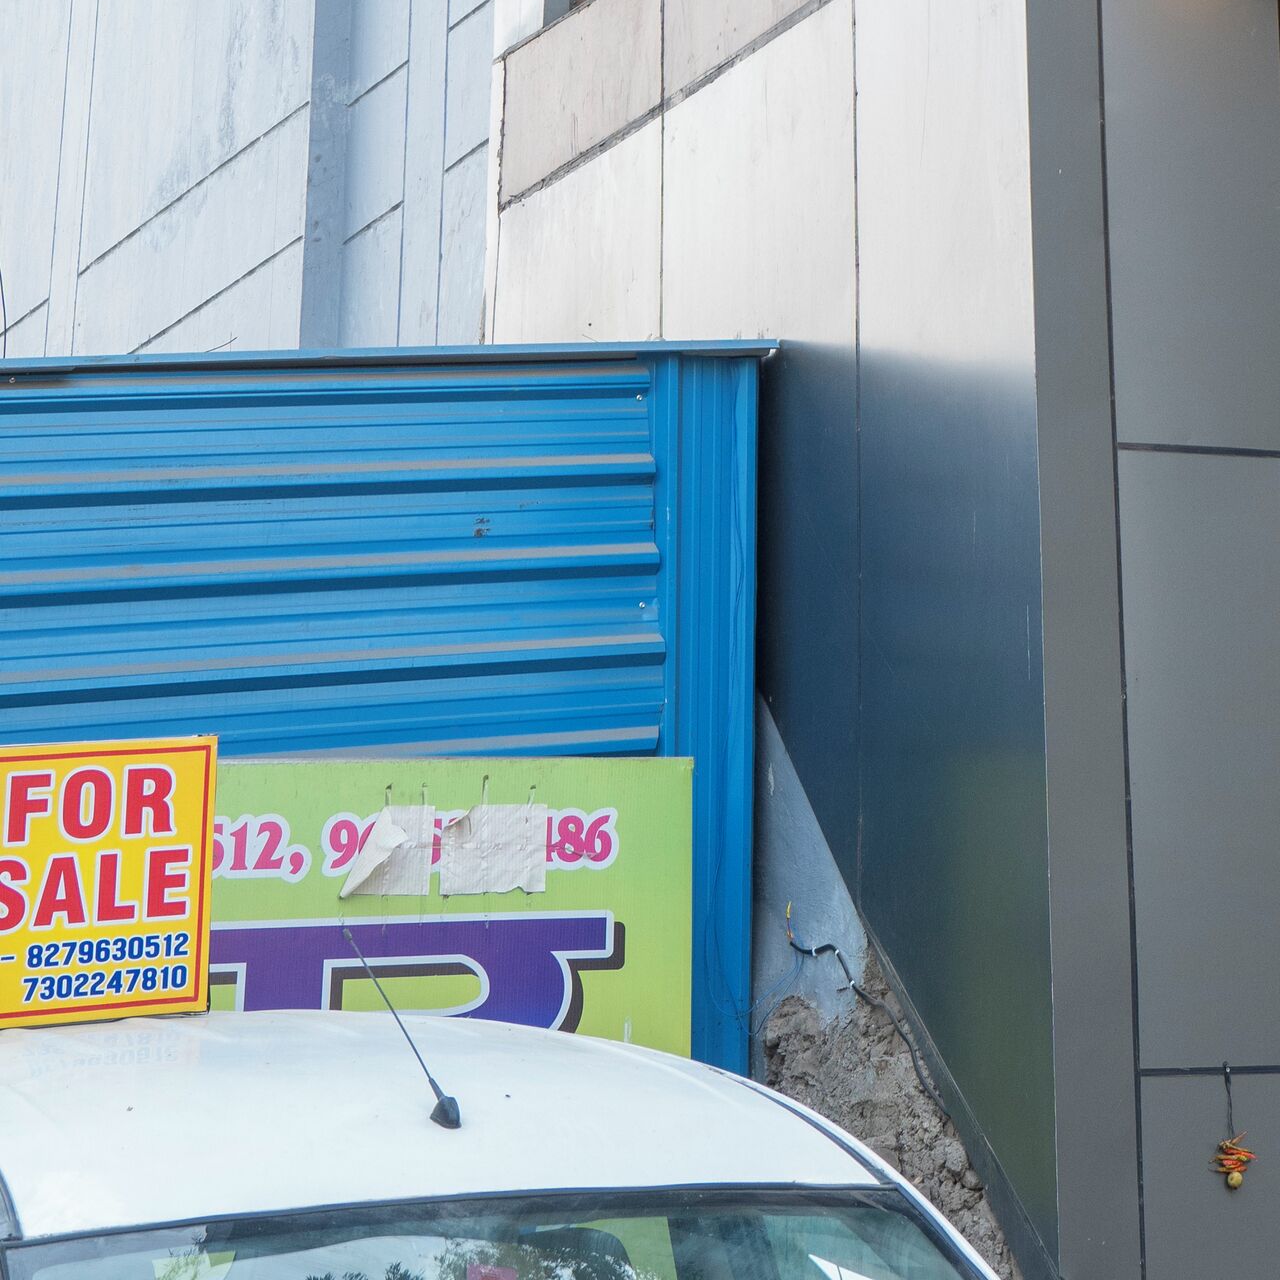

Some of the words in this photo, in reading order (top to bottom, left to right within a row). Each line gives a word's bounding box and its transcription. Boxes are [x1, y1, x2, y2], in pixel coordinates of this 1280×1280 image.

[7, 767, 174, 843] FOR
[0, 848, 190, 931] SALE
[26, 932, 190, 969] 8279630512
[23, 964, 188, 1002] 7302247810
